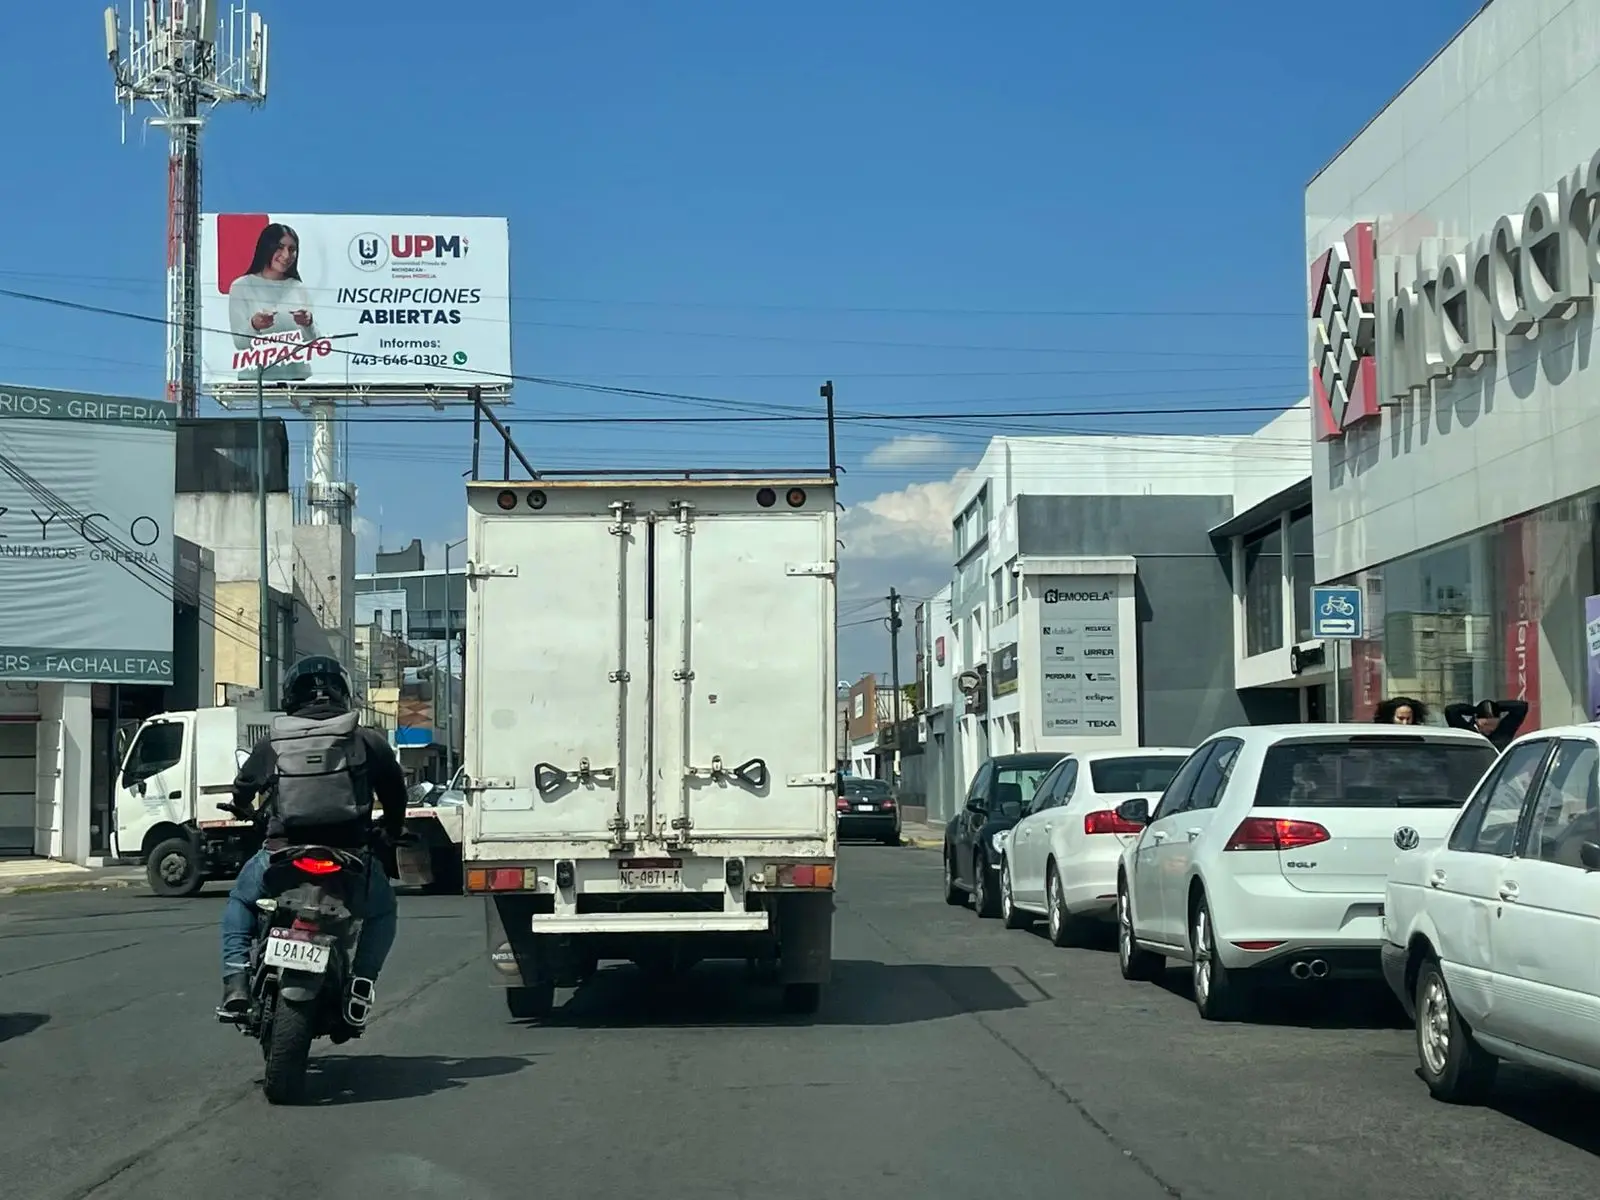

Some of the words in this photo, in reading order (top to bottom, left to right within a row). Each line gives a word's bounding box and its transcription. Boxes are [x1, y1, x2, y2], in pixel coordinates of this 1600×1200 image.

[391, 235, 460, 258] UPM
[337, 288, 481, 304] INSCRIPCIONES
[358, 309, 461, 324] ABIERTAS
[253, 331, 301, 346] GENERA
[379, 338, 441, 348] Informes:
[232, 340, 332, 370] IMPACTO
[351, 354, 448, 366] 443-646-0302
[46, 656, 171, 675] FACHALETAS
[620, 870, 680, 885] NC-4871-A
